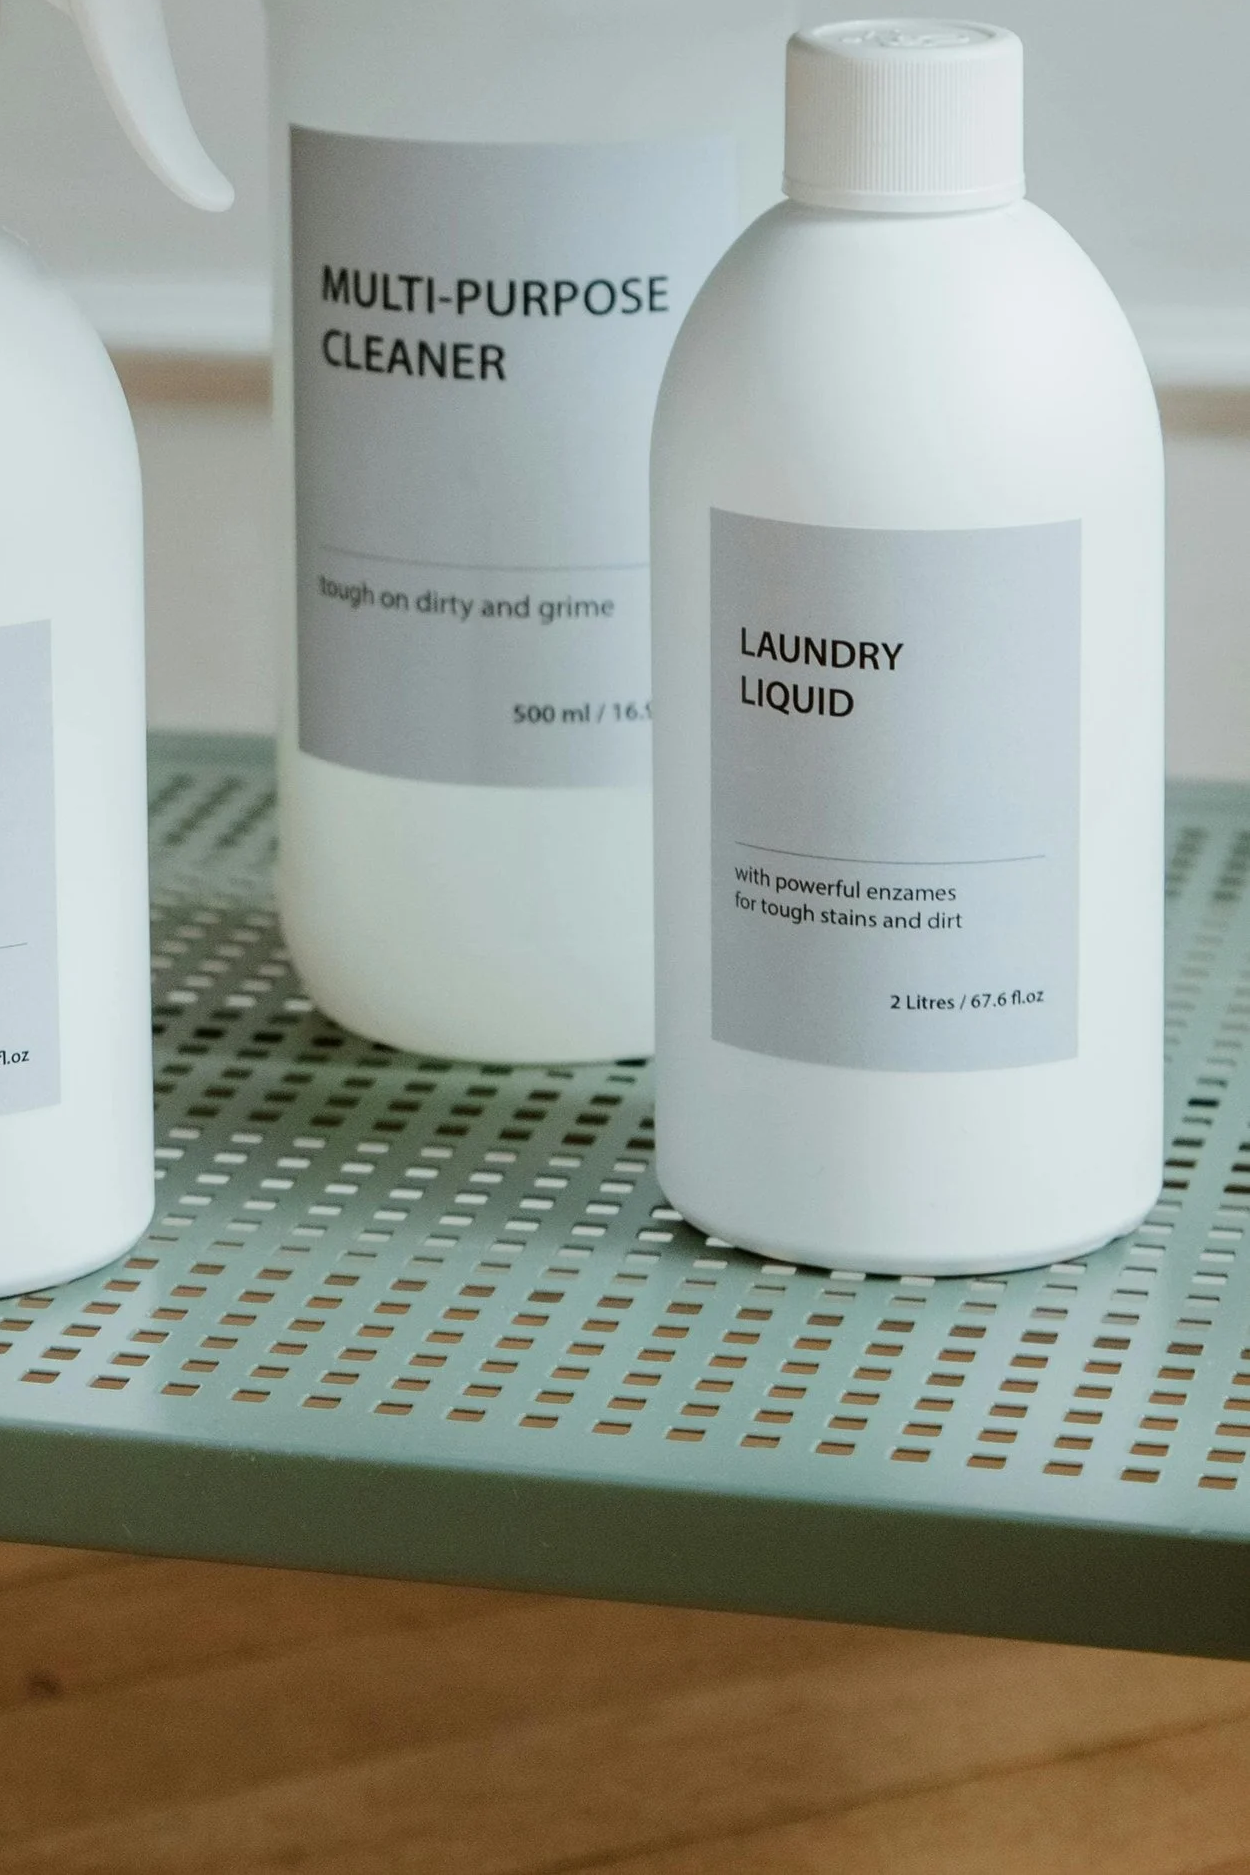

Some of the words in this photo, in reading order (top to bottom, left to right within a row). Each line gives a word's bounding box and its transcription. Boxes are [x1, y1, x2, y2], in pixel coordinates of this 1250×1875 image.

[323, 266, 667, 317] MULTI-PURPOSE
[323, 329, 506, 381] CLEANER
[319, 576, 375, 609] tough
[380, 591, 409, 610] on
[415, 591, 473, 621] dirty
[481, 595, 530, 618] and
[538, 596, 615, 624] grime
[742, 627, 903, 670] LAUNDRY
[514, 705, 555, 724] 500
[562, 703, 590, 723] ml
[596, 704, 606, 723] /
[742, 676, 854, 717] LIQUID
[735, 866, 770, 887] with
[776, 877, 860, 898] powerful
[867, 887, 956, 901] enzames
[735, 891, 756, 911] for
[761, 899, 814, 924] tough
[821, 909, 877, 927] stains
[883, 912, 921, 929] and
[928, 912, 961, 929] dirt
[891, 995, 900, 1009] 2
[907, 995, 954, 1010] Litres
[959, 995, 966, 1010] /
[971, 993, 1007, 1008] 67.6
[1011, 990, 1043, 1005] fl.oz
